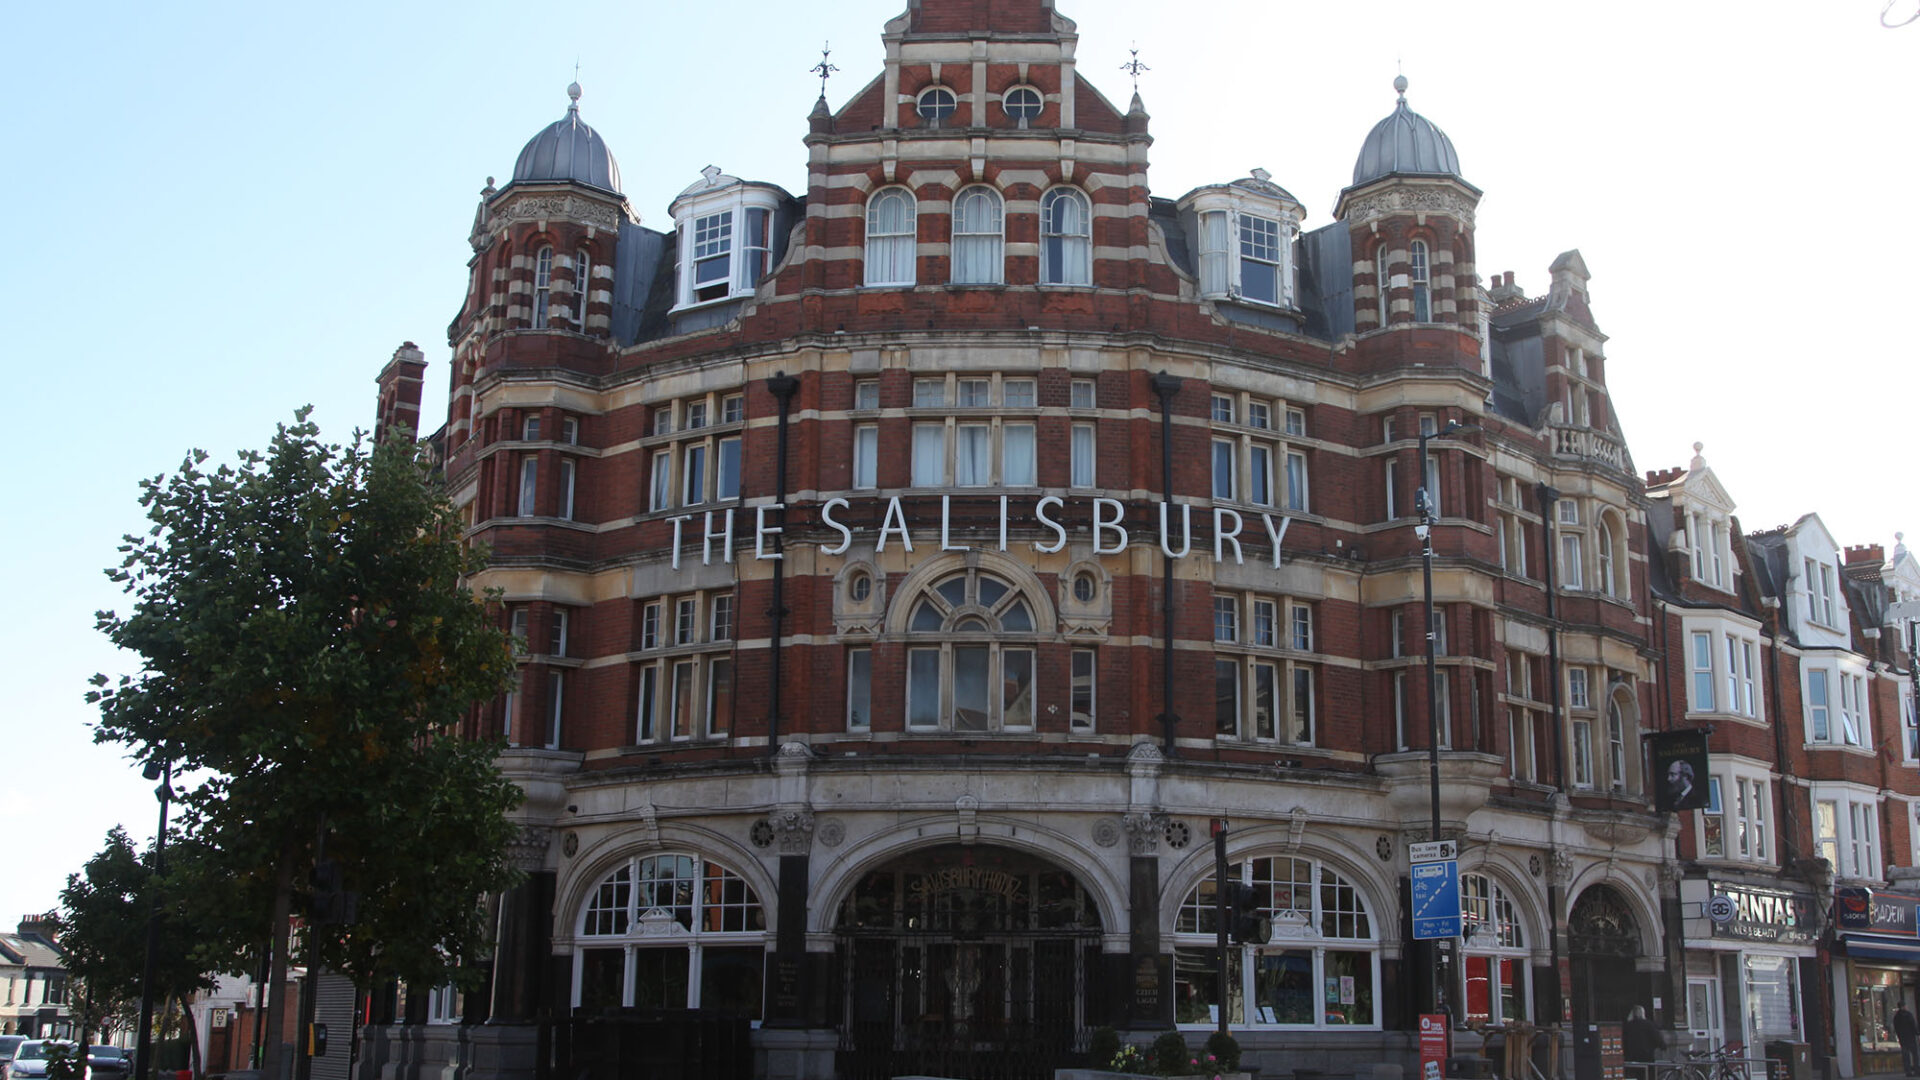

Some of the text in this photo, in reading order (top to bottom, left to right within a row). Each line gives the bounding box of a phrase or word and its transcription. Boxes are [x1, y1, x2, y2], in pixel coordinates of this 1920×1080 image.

[665, 495, 1291, 571] THE SALISBURY
[1411, 845, 1421, 853] Bus
[1413, 852, 1437, 860] cameras
[910, 867, 983, 900] SALISBURY
[1753, 927, 1777, 938] BEAUTY
[216, 1010, 225, 1026] MOT
